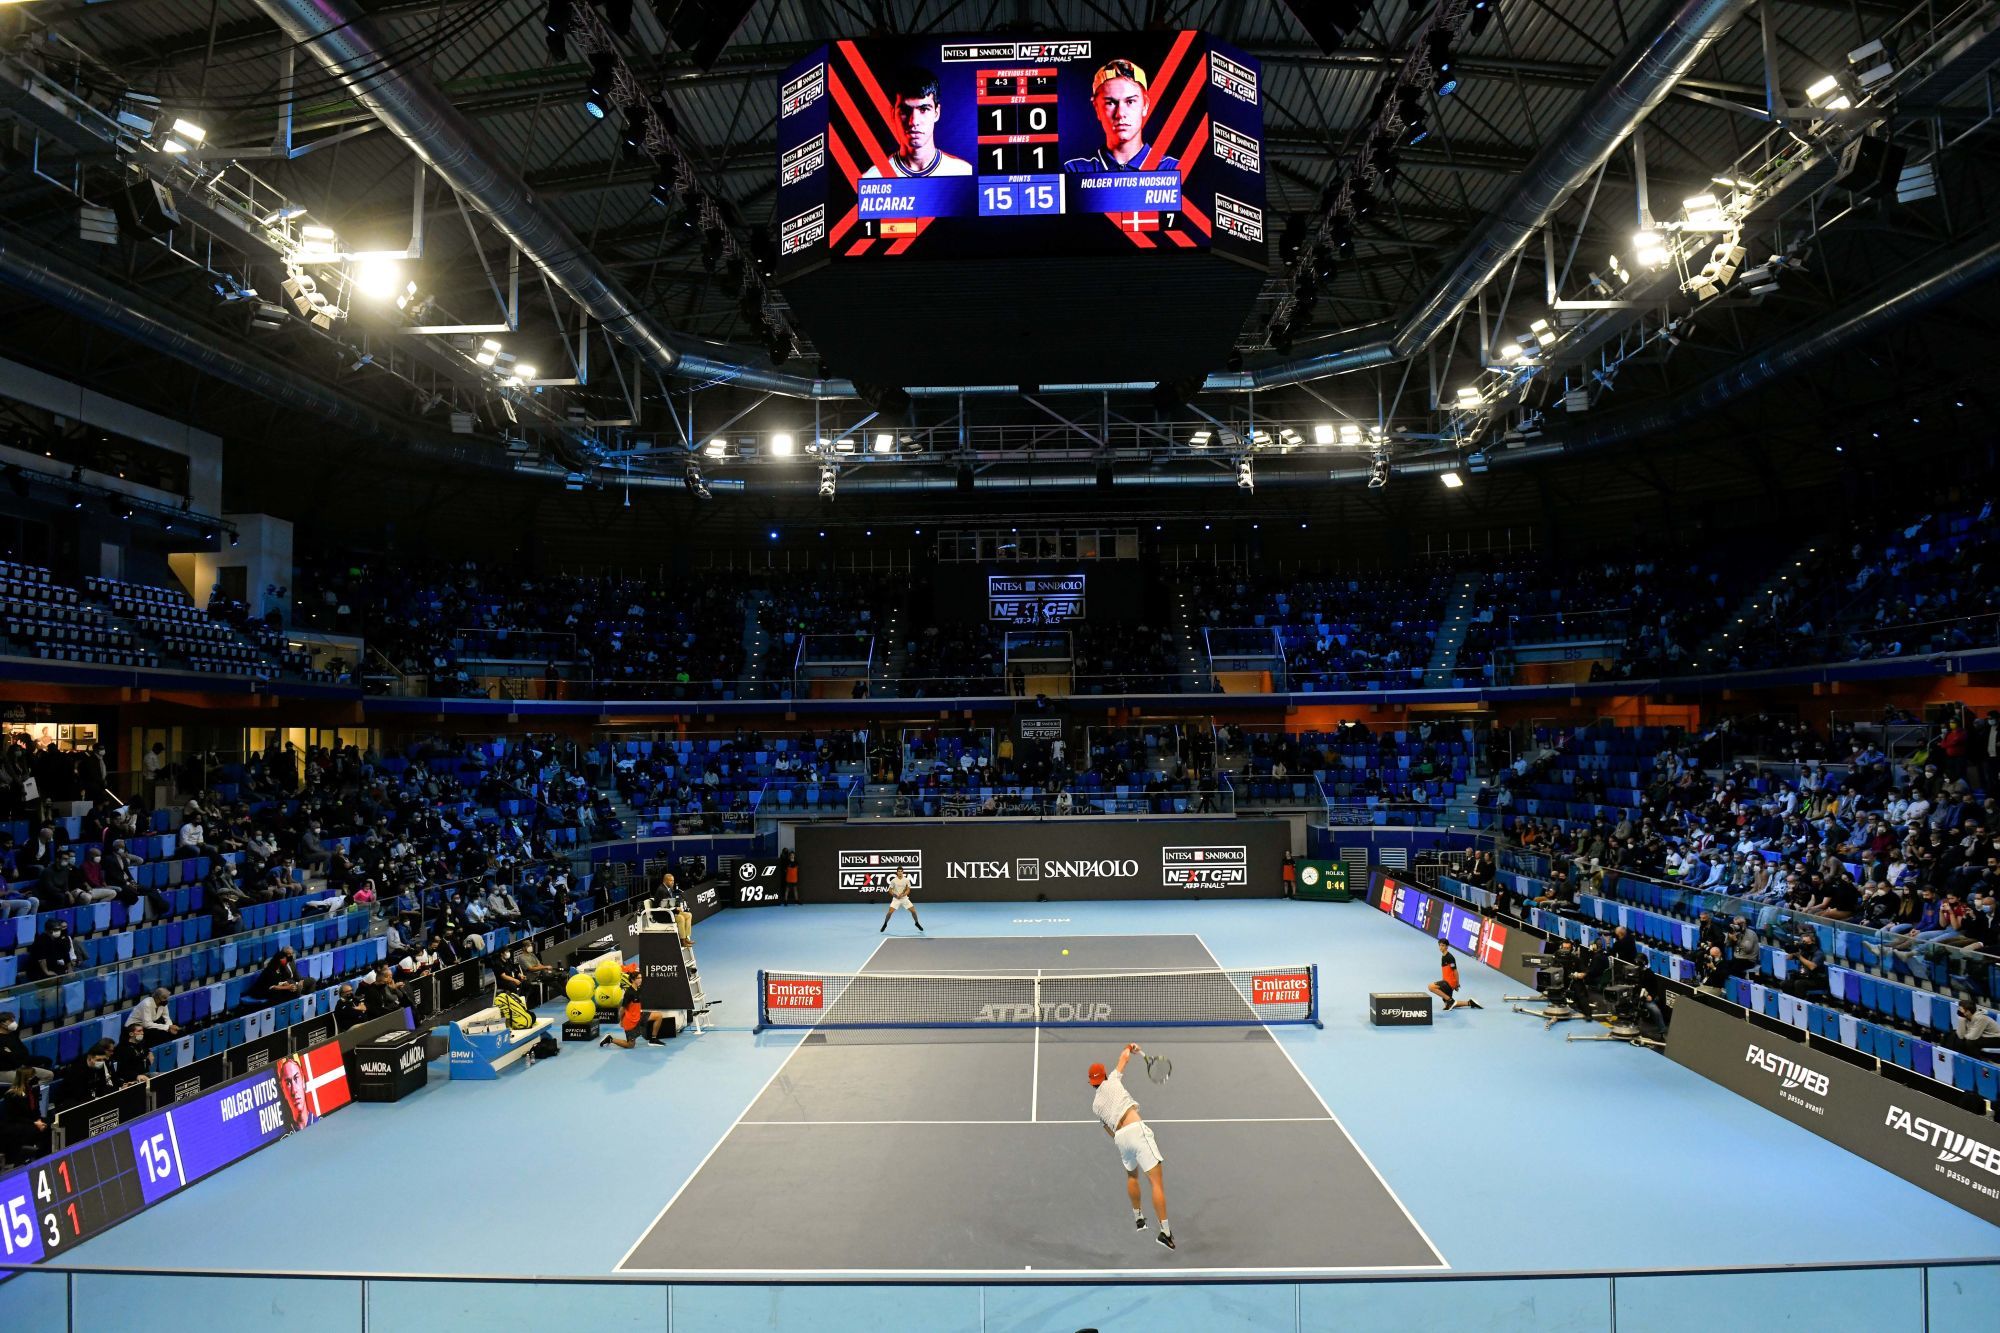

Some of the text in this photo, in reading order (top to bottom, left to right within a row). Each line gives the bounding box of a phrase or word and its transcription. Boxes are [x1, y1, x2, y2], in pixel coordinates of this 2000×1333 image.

[944, 49, 968, 57] INTESA
[1020, 44, 1087, 57] NEXT GEN
[995, 78, 1008, 86] 4-3
[1238, 85, 1254, 100] GEN
[1010, 96, 1026, 104] SETS
[991, 107, 1047, 131] 1 0
[1008, 135, 1030, 143] GAMES
[992, 146, 1044, 170] 1 1
[1240, 154, 1257, 168] GEN
[1008, 175, 1031, 183] POINTS
[1081, 176, 1178, 189] HOLGER VITUS NODSKOV
[861, 184, 892, 195] CARLOS
[983, 185, 1054, 210] 15 15
[1145, 189, 1178, 204] RUNE
[860, 197, 916, 212] ALCARAZ
[1166, 213, 1175, 228] 7
[865, 221, 872, 236] 1
[1243, 225, 1260, 238] GEN
[992, 581, 1082, 591] INTESA SANPAOLO
[842, 855, 919, 864] INTESA SANPAOLO
[1166, 851, 1244, 860] INTESA SANPAOLO
[946, 859, 1139, 879] INTESA SANPAOLO
[1167, 869, 1243, 882] NEXT GEN
[843, 873, 886, 886] NEXT
[1326, 880, 1345, 890] 0:44
[740, 885, 764, 902] 193
[650, 964, 678, 972] SPORT
[769, 983, 822, 996] Emirates
[1253, 978, 1308, 991] Emirates
[776, 996, 814, 1006] FLY BETTER
[1262, 990, 1300, 1001] FLY BETTER
[973, 1003, 1112, 1022] ATP TOUR
[400, 1045, 425, 1070] VALMORA
[360, 1061, 392, 1073] VALMORA
[1745, 1044, 1830, 1097] FASTWEB
[220, 1086, 253, 1122] HOLGER
[253, 1077, 278, 1107] VITUS
[1779, 1090, 1825, 1115] un passo avanti
[259, 1102, 284, 1135] RUNE
[139, 1133, 171, 1183] 15
[37, 1160, 72, 1203] 4 1
[1935, 1163, 2000, 1200] un passo avanti
[44, 1203, 81, 1247] 3 1
